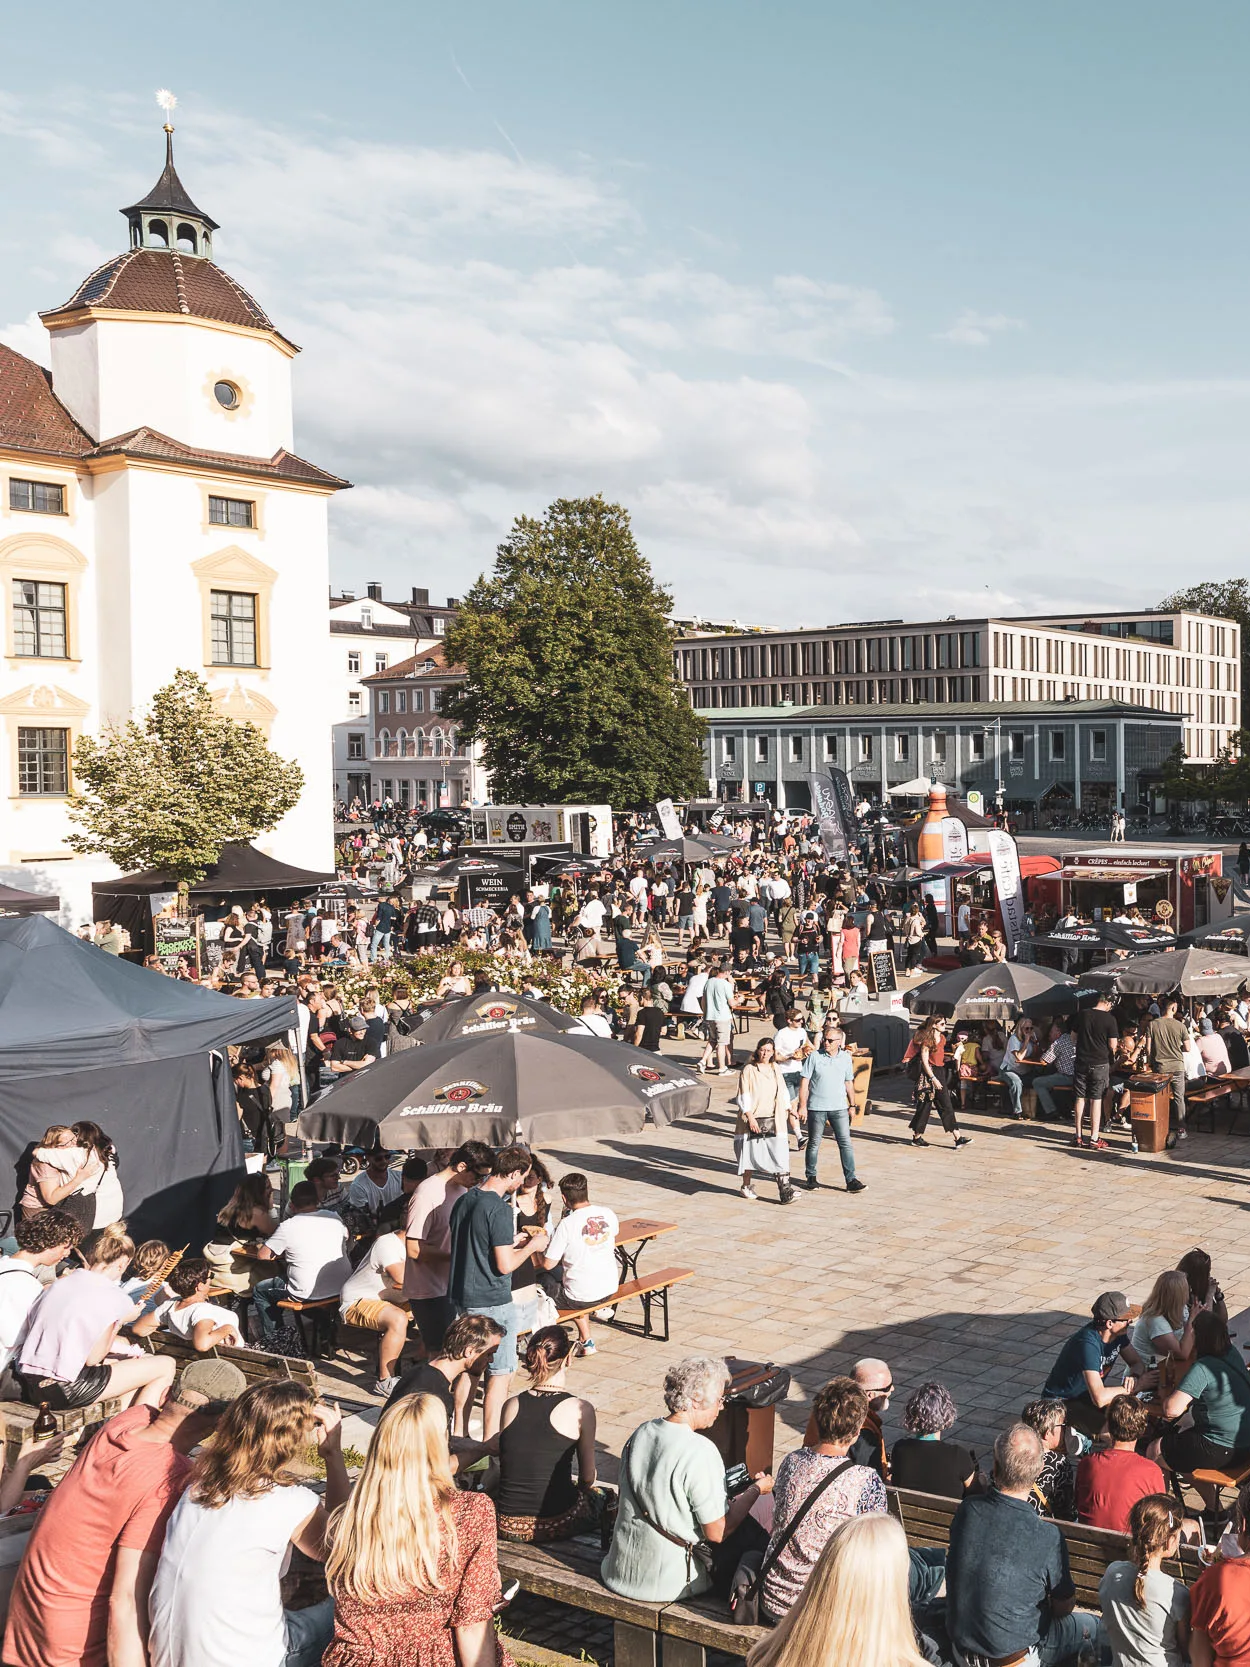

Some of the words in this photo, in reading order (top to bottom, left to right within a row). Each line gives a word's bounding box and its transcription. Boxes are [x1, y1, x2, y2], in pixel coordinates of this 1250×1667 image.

[462, 1021, 508, 1035] Schäffler
[509, 1016, 536, 1030] Bräu
[400, 1104, 465, 1116] Schäffler
[466, 1103, 503, 1114] Bräu
